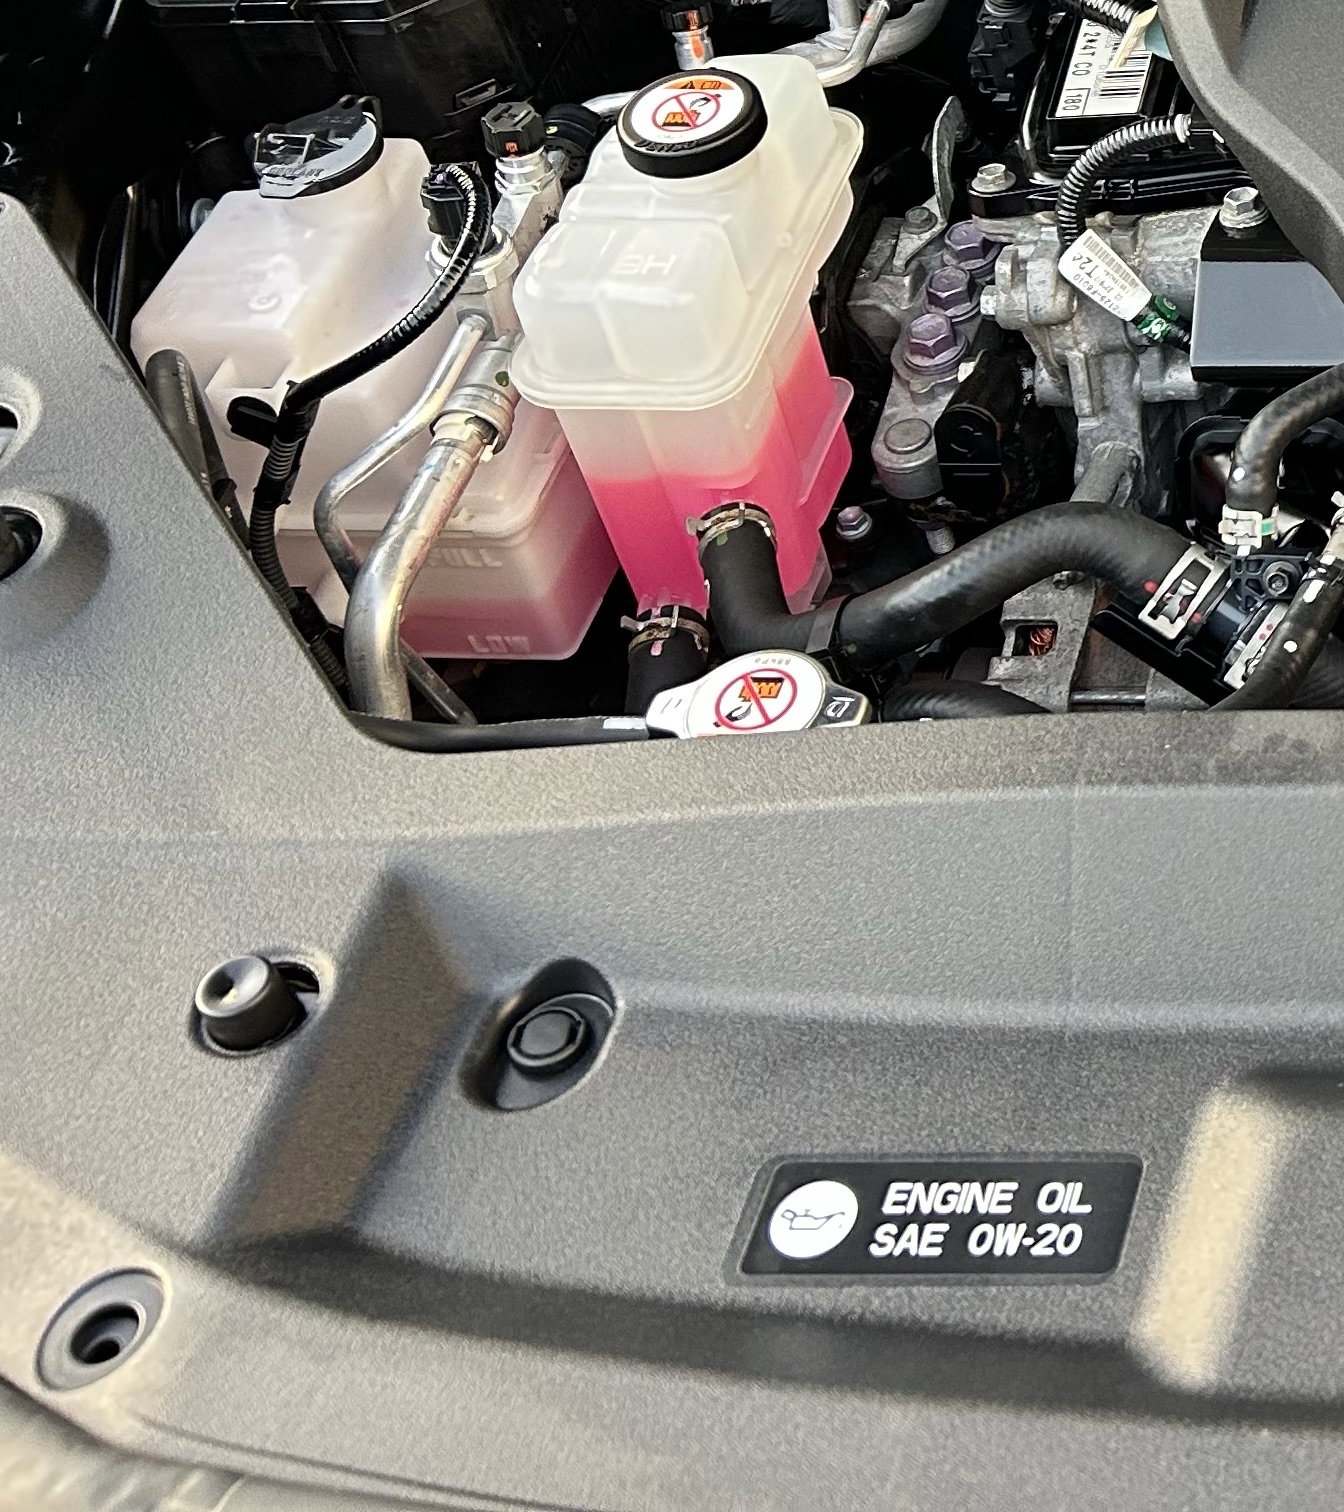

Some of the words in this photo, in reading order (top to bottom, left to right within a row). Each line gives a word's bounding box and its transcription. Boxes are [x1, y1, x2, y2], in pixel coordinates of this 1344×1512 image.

[1062, 94, 1083, 111] 180
[466, 635, 530, 653] LOW
[881, 1181, 1019, 1214] ENGINE
[1036, 1181, 1093, 1214] OIL
[868, 1222, 950, 1256] SAE
[967, 1222, 1083, 1256] 0W-20
